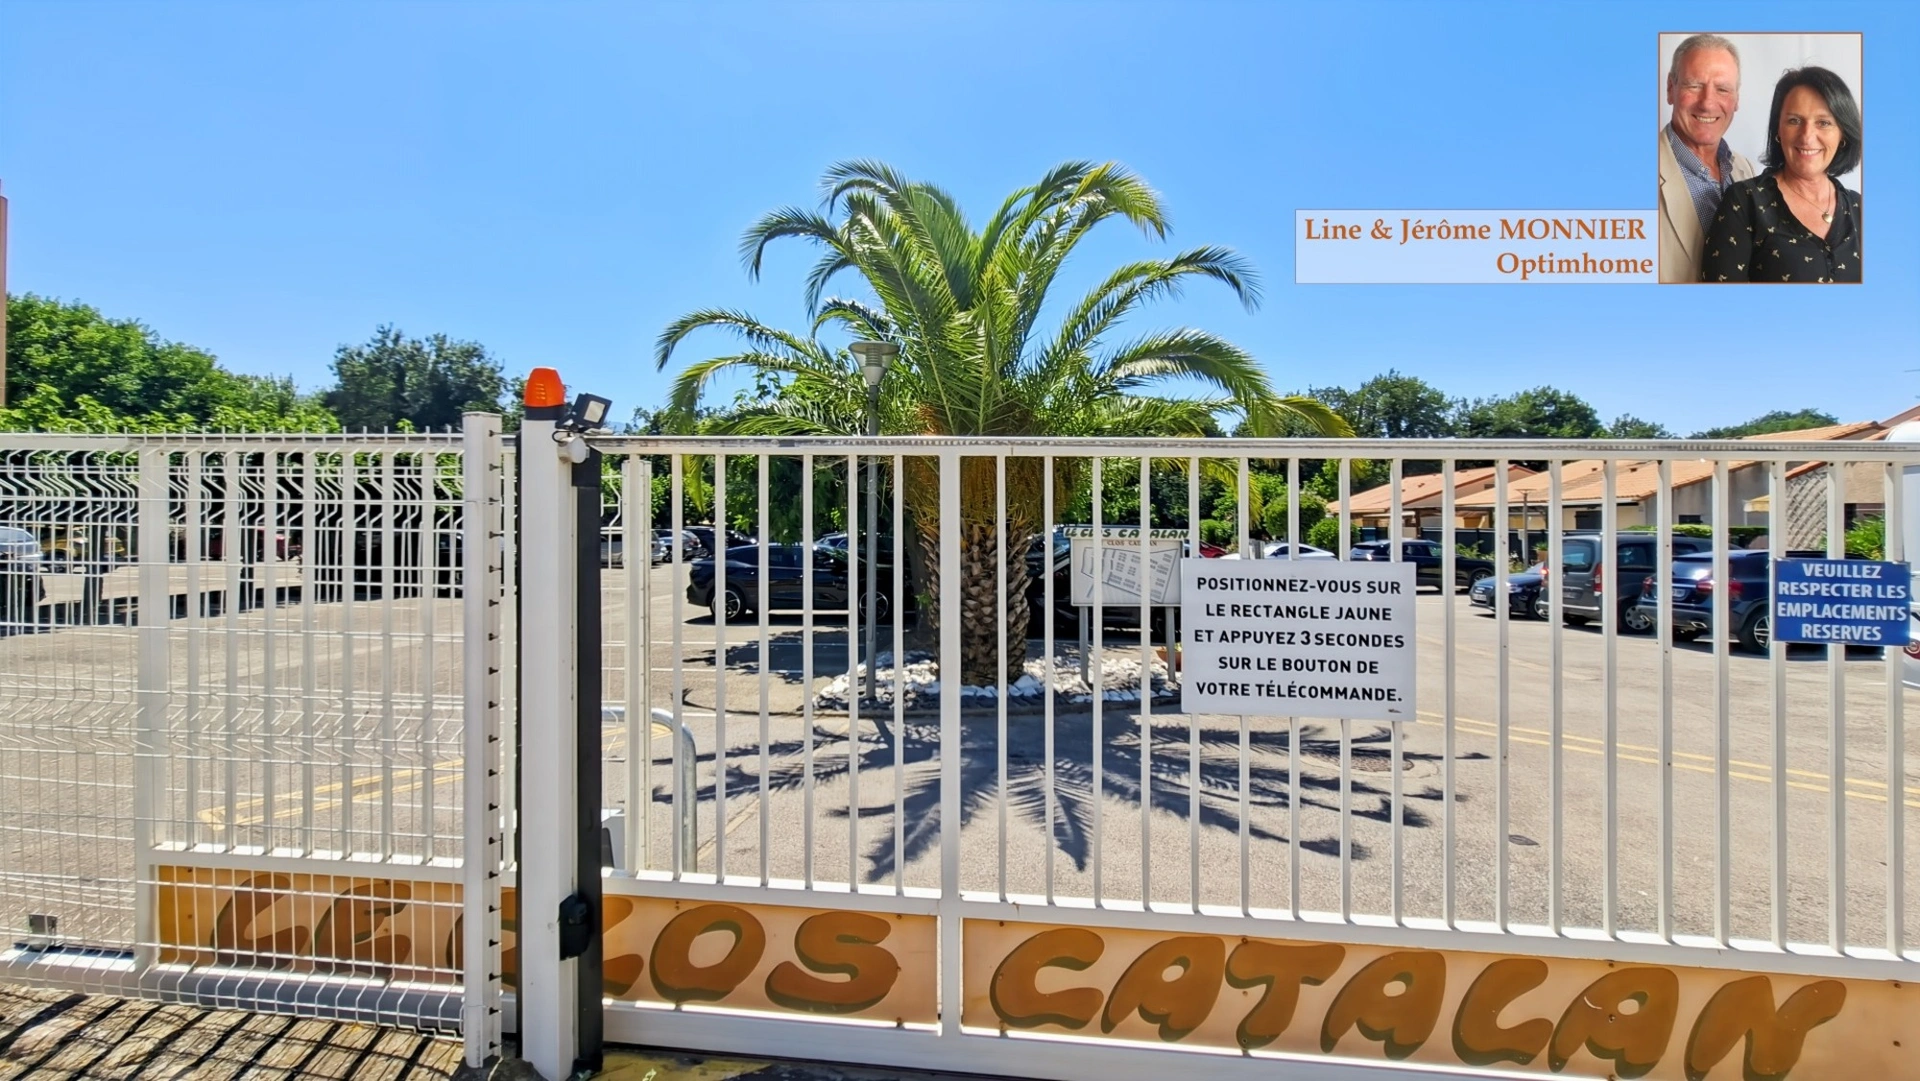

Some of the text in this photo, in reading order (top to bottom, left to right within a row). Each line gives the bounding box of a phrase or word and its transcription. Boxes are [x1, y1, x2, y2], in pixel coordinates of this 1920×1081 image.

[1118, 529, 1189, 539] CAALAN
[1802, 563, 1882, 578] VEUILLEZ
[1197, 577, 1401, 595] POSITIONNEZ-VOUS SUR
[1778, 582, 1907, 599] RESPECTER LES
[1206, 603, 1392, 621] LE RECTANGLE JAUNE
[1777, 602, 1907, 621] EMPLACEMENTS
[1194, 629, 1405, 648] ET APPUYEZ 3 SECONDES
[1801, 624, 1882, 641] RESERVES
[1218, 656, 1379, 674] SUR LE BOUTON DE
[1196, 679, 1403, 702] VOTRE TÉLÉCOMMANDE.
[209, 873, 412, 977] LE
[990, 927, 1847, 1081] CATALAN
